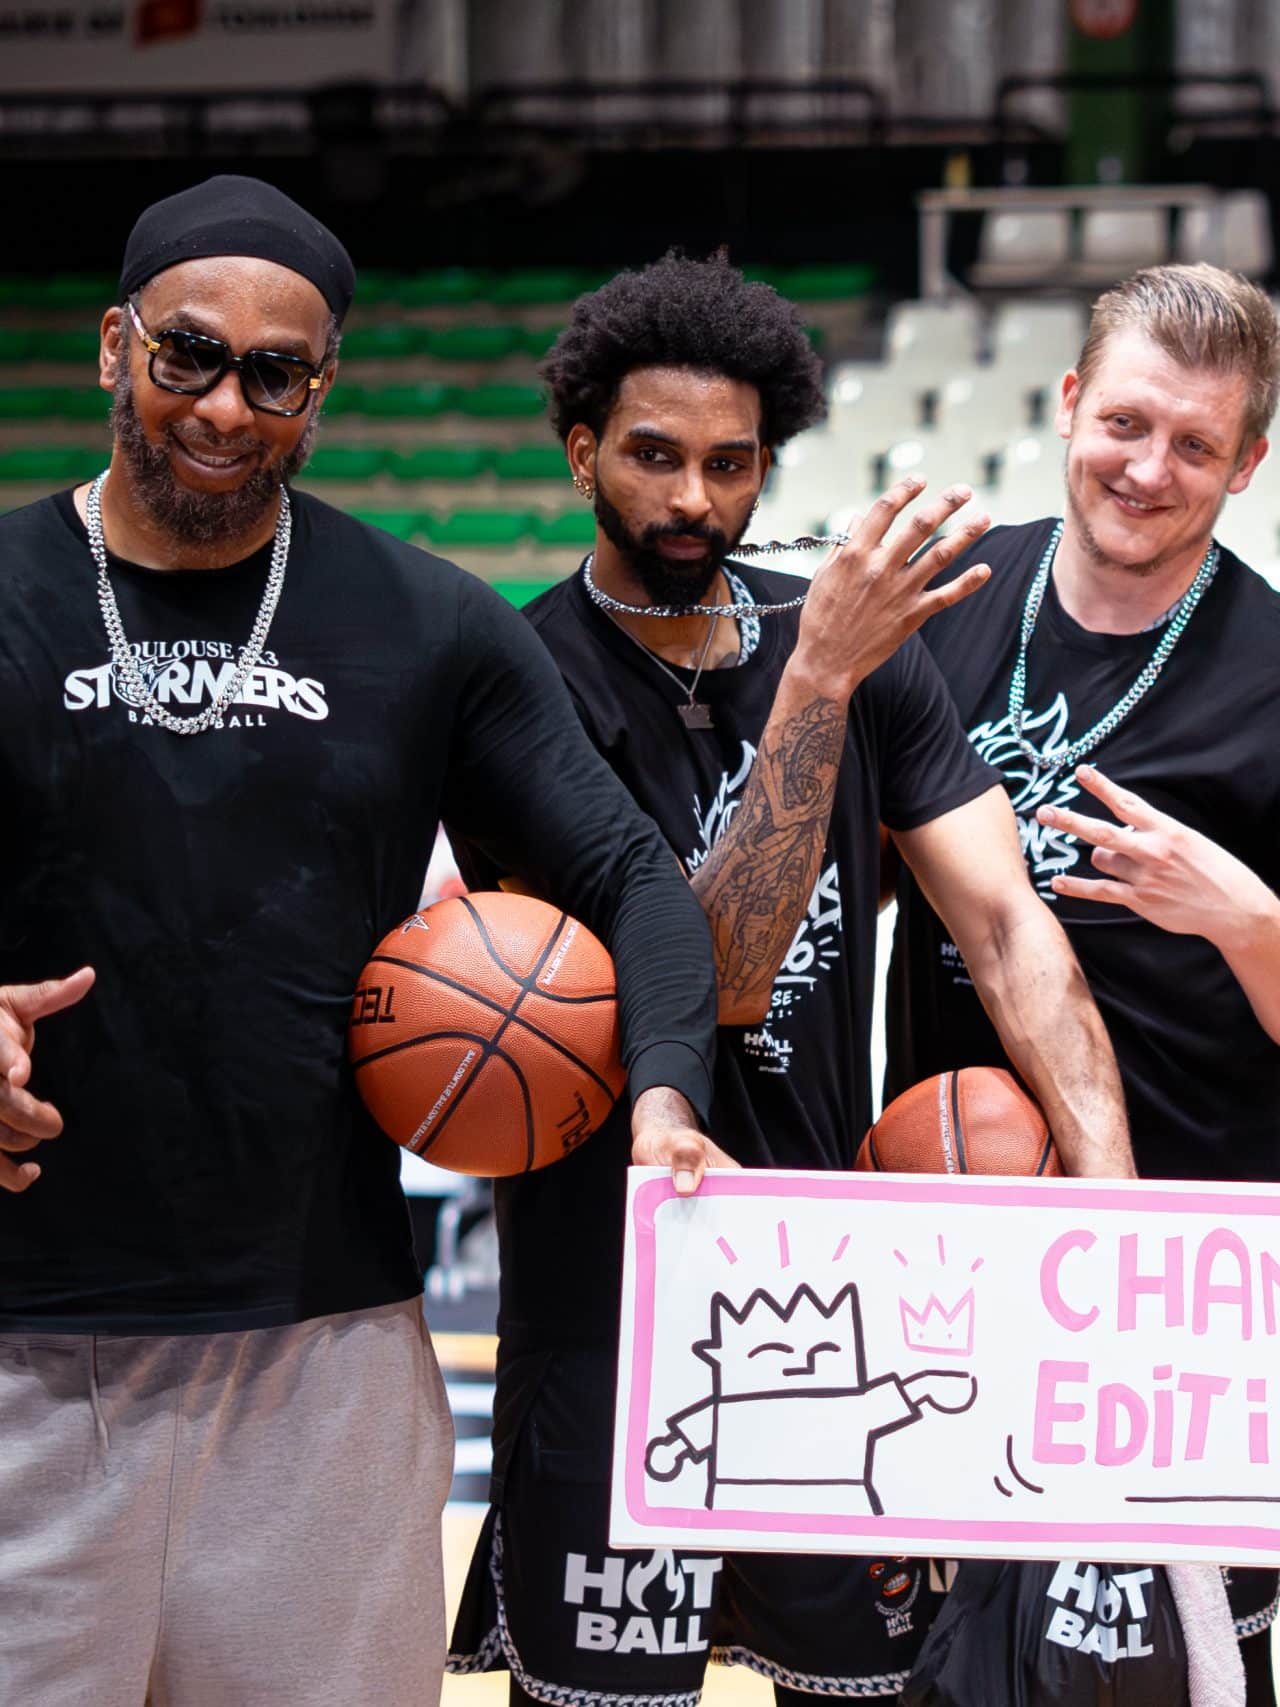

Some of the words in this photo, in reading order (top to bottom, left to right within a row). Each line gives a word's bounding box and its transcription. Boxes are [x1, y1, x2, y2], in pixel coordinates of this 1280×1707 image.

[564, 1549, 723, 1612] HOT
[576, 1611, 709, 1654] BALL
[1045, 1606, 1154, 1663] BALL
